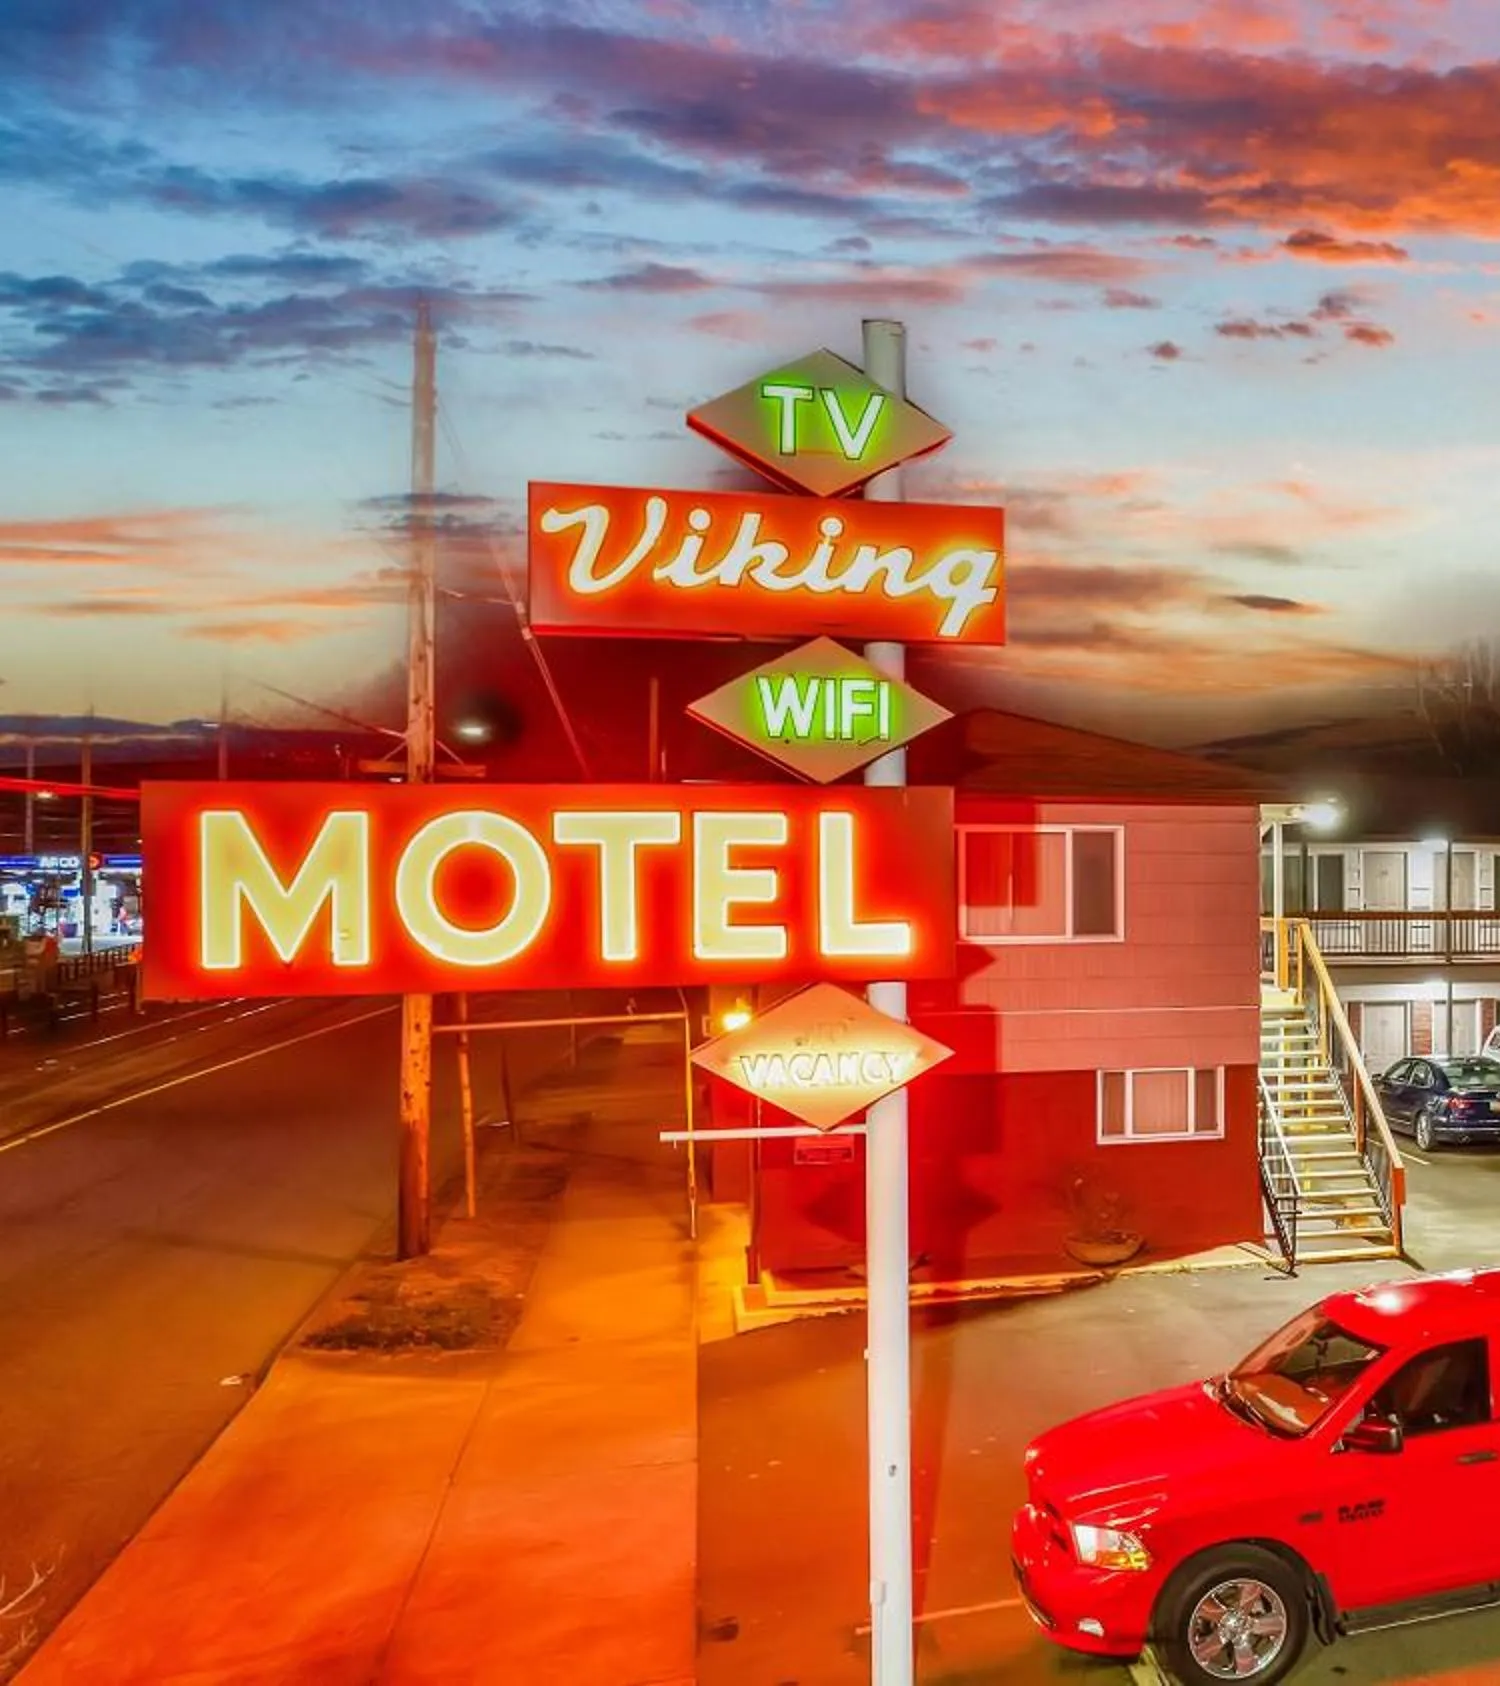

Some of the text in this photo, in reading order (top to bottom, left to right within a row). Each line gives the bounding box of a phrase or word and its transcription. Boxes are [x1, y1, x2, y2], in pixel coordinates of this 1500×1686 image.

[761, 383, 885, 461] TV
[540, 496, 999, 637] Viking
[756, 676, 890, 741] WIFI
[200, 809, 912, 969] MOTEL
[740, 1051, 911, 1088] VACANCY
